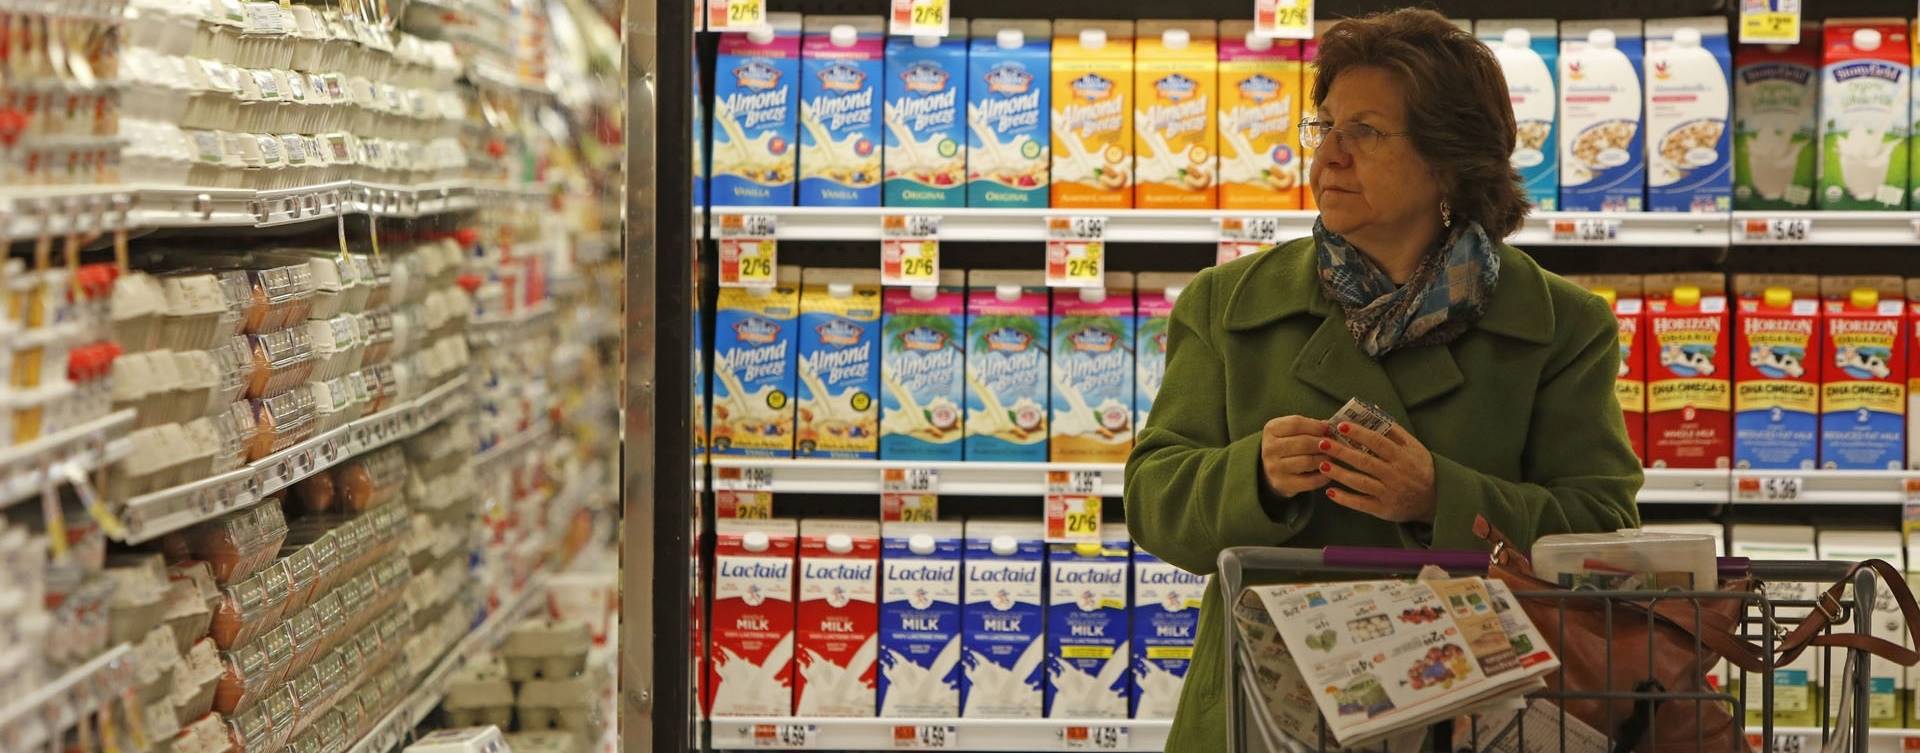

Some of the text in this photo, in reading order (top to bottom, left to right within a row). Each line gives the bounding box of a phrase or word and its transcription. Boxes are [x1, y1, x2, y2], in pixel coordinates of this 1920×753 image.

[724, 85, 788, 115] Almond
[808, 86, 873, 117] Almond
[892, 87, 956, 118] Almond
[975, 88, 1040, 120] Almond
[724, 340, 787, 371] Almond
[808, 341, 870, 371] Almond
[721, 562, 788, 579] Lactaid
[806, 563, 872, 580] Lactaid
[888, 565, 954, 582] Lactaid
[970, 566, 1037, 583] Lactaid
[1056, 567, 1121, 585] Lactaid
[736, 619, 769, 631] MILK
[821, 621, 854, 632] MILK
[902, 618, 939, 631] MILK
[984, 619, 1021, 632] MILK
[1071, 625, 1104, 637] MILK
[1156, 625, 1190, 637] MILK
